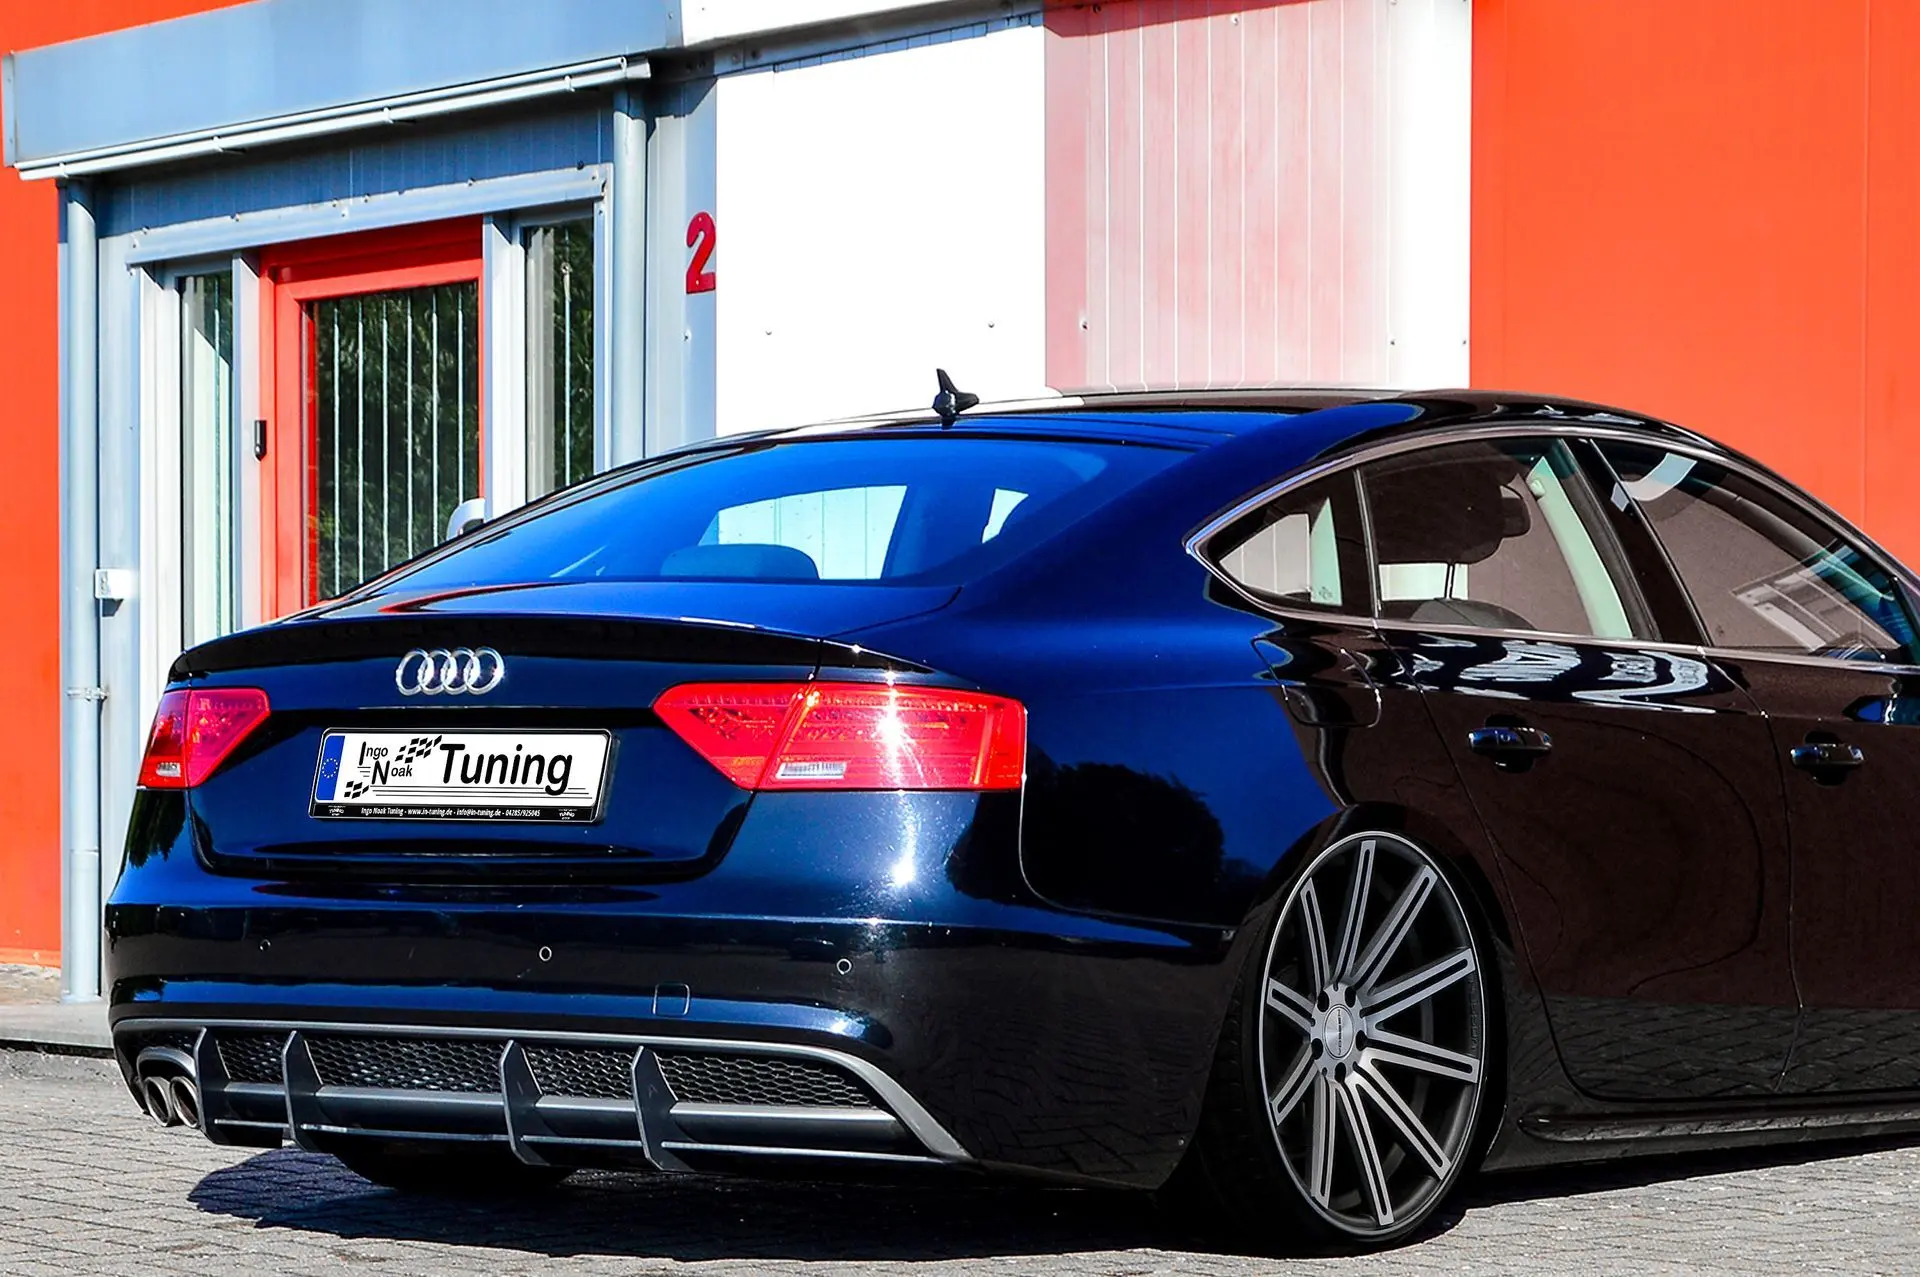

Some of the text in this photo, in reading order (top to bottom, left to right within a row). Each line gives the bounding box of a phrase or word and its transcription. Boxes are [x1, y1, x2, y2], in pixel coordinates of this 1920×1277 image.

[686, 211, 716, 295] 2
[359, 741, 389, 766] Ingo
[371, 760, 413, 785] Noak
[439, 743, 573, 796] Tuning
[361, 807, 372, 816] Ingo
[373, 807, 386, 815] Noak
[387, 807, 404, 817] Tuning
[407, 808, 453, 817] www.in-tuning.de
